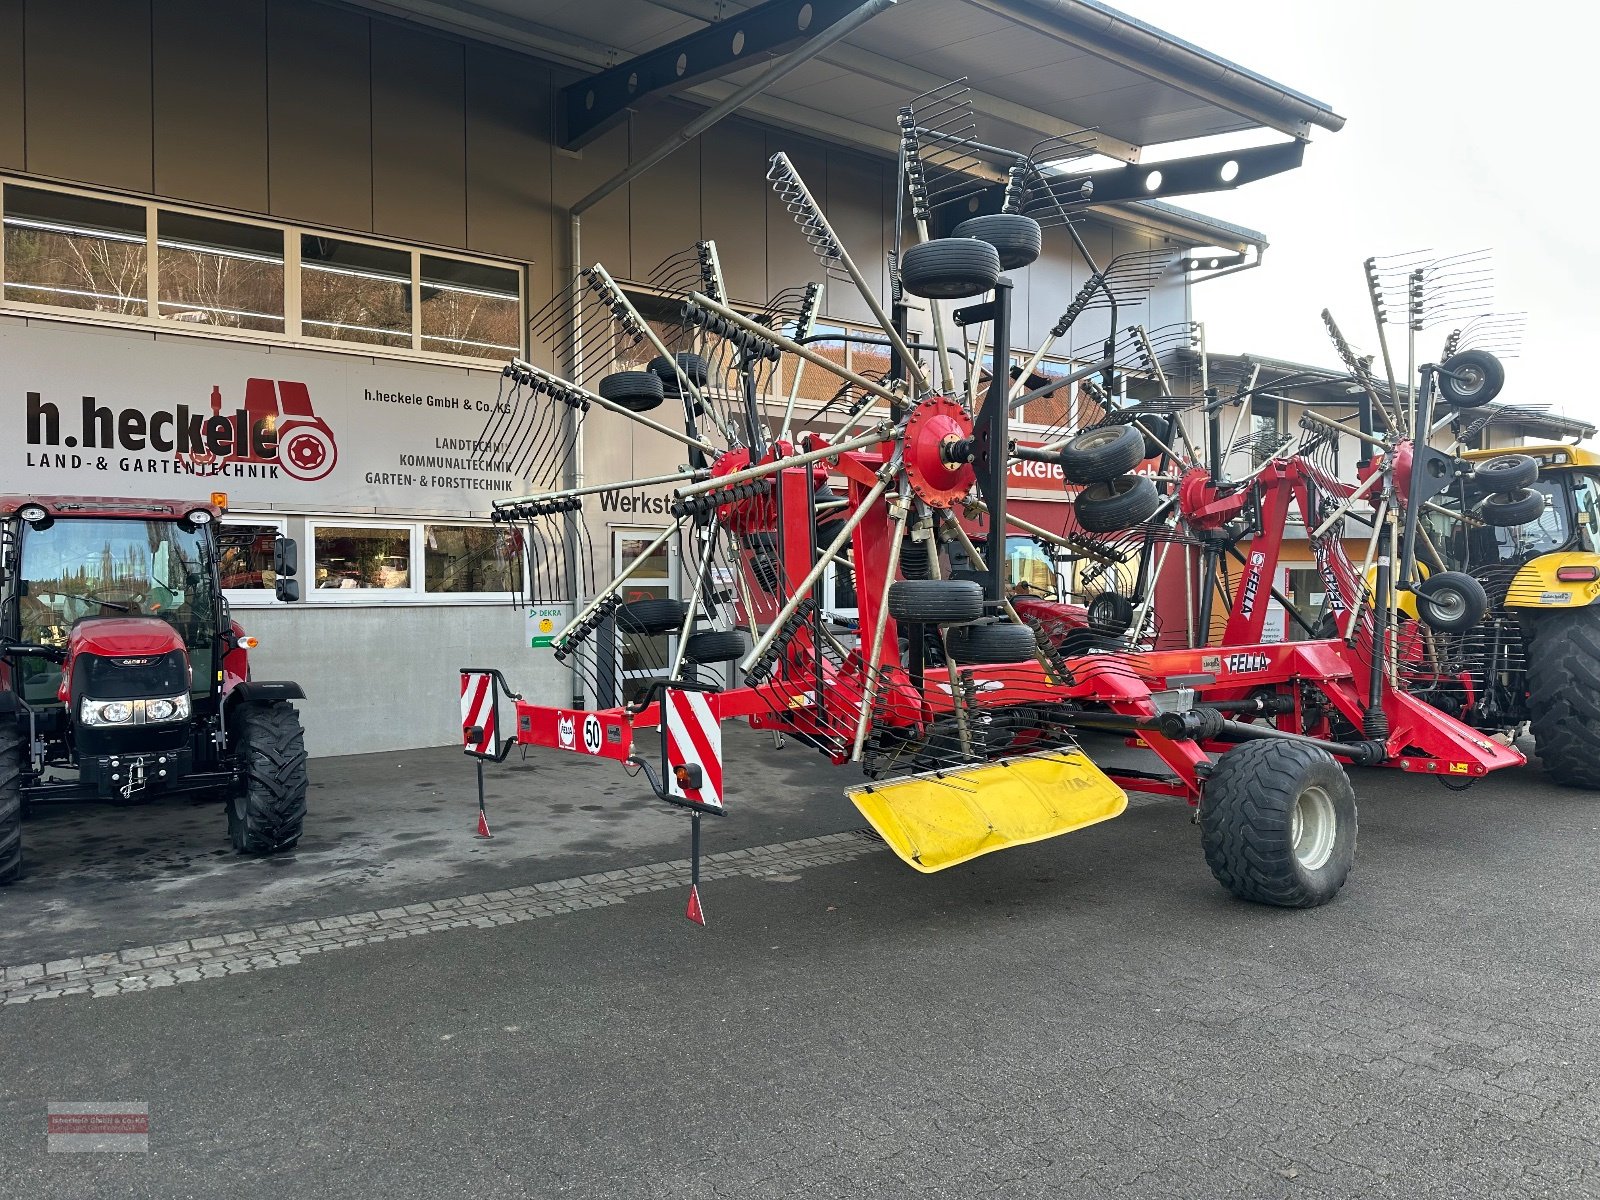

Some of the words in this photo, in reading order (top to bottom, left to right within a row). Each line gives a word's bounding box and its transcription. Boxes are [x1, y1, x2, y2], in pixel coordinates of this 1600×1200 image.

[364, 388, 423, 405] h.heckele
[427, 395, 459, 409] GmbH
[463, 399, 472, 410] &
[475, 400, 493, 412] Co.
[497, 402, 511, 414] KG
[27, 392, 279, 458] h.heckele
[119, 457, 279, 479] GARTENTECHNIK
[399, 453, 512, 473] KOMMUNALTECHNIK
[365, 472, 417, 486] GARTEN-
[420, 475, 428, 487] &
[431, 476, 512, 491] FORSTTECHNIK
[599, 489, 675, 514] Werkst
[1240, 569, 1260, 613] FELLA
[539, 609, 562, 617] DEKRA
[1229, 652, 1268, 673] FELLA
[585, 720, 600, 748] 50
